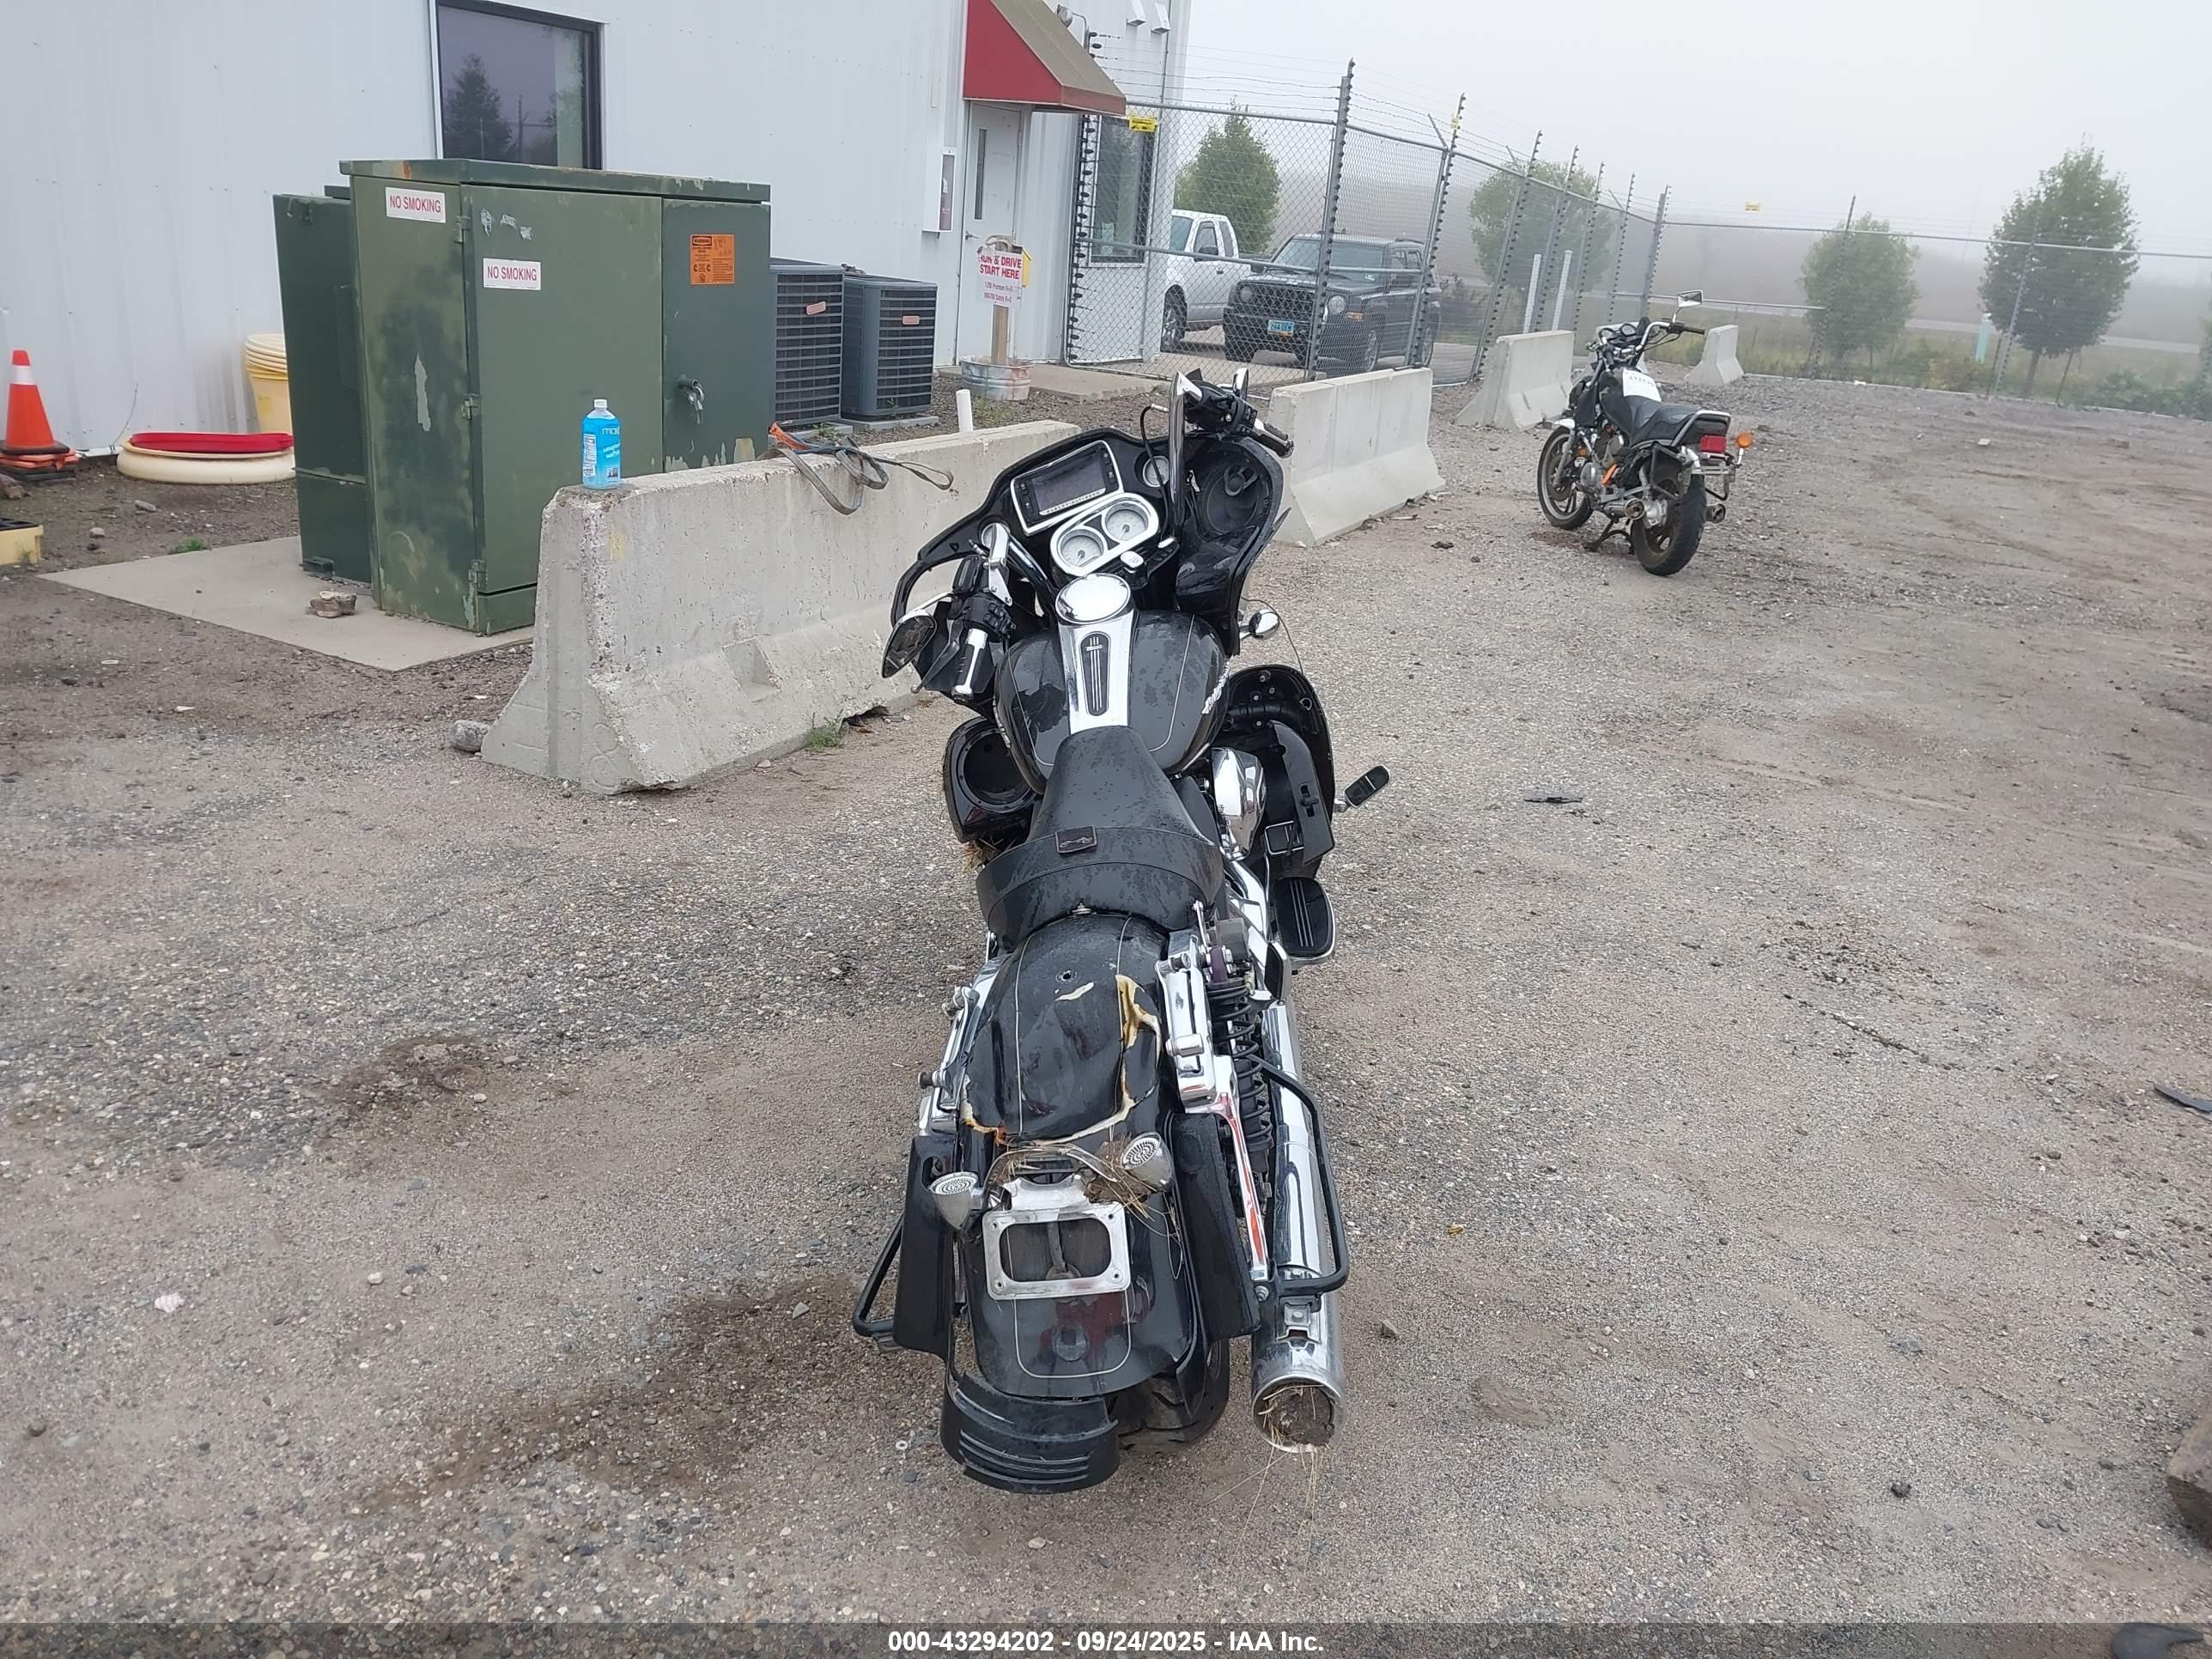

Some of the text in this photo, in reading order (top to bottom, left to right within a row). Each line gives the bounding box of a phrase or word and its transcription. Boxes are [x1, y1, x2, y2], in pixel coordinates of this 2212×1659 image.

[389, 195, 441, 214] NO SMOKING
[1000, 256, 1022, 269] DRIVE
[487, 265, 537, 282] NO SMOKING
[980, 264, 1020, 280] START HERE
